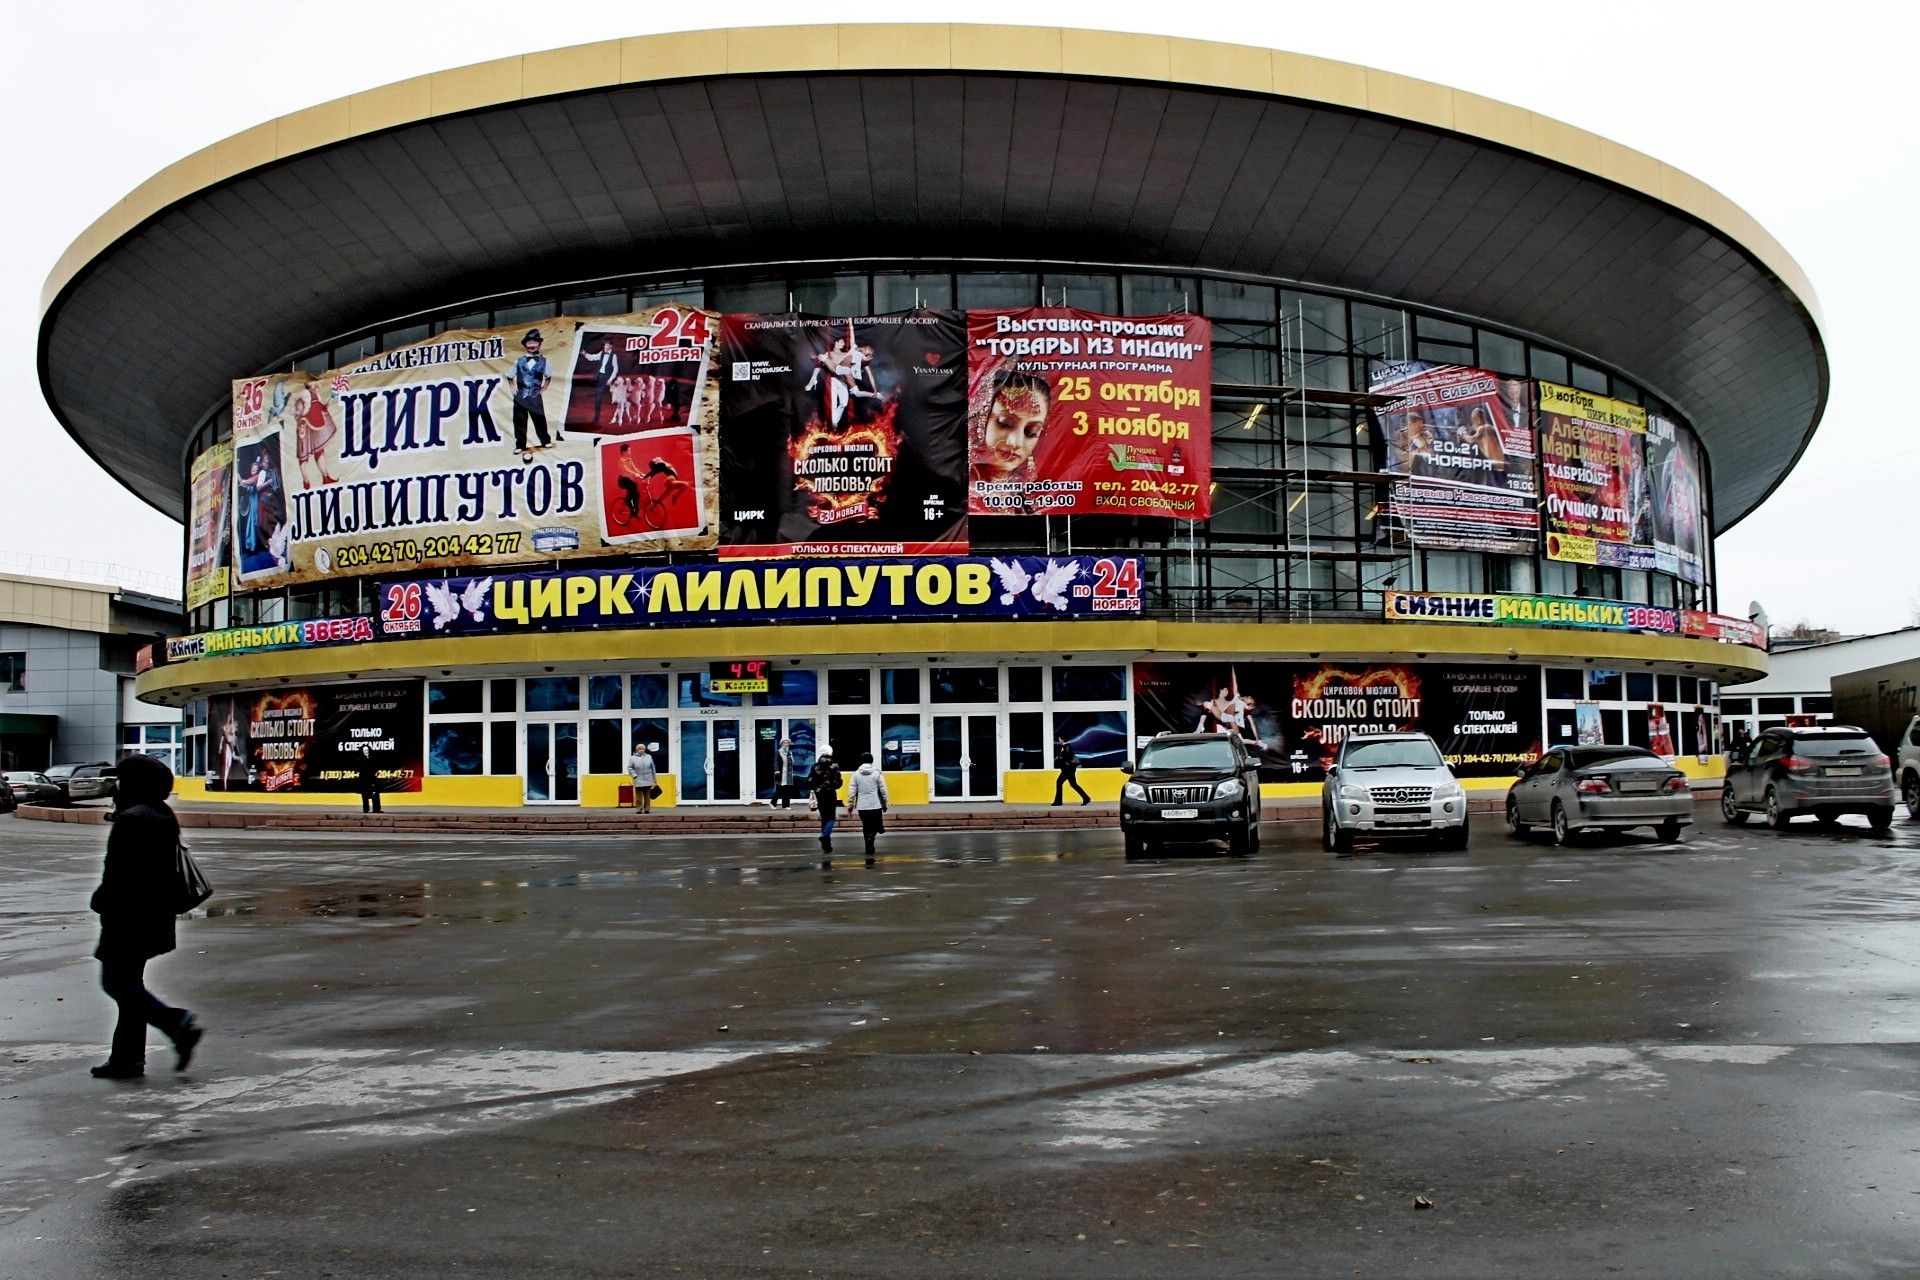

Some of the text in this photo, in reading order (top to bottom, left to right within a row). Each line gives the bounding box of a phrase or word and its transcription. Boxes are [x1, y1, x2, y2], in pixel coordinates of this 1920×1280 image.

[652, 308, 712, 347] 24
[744, 320, 797, 330] СКАНДАЛЬНОЕ
[854, 317, 902, 325] ВЗОРВАВШЕЕ
[997, 316, 1184, 337] Выставка-продажа
[627, 338, 647, 350] ПО
[1087, 339, 1115, 355] ИЗ
[640, 348, 701, 363] НОЯБРЯ
[1017, 361, 1173, 374] КУЛЬТУРНАЯ ПРОГРАММА
[1058, 376, 1201, 411] 25 октября
[1428, 390, 1438, 403] В
[1441, 379, 1495, 401] СИБИРИ
[1543, 385, 1554, 399] 19
[340, 377, 502, 468] ЦИРК
[1072, 411, 1190, 443] 3 ноября
[844, 444, 874, 452] МЮЗИКЛ
[794, 457, 893, 475] СКОЛЬКО СТОИТ
[1428, 455, 1492, 471] НОЯБРЯ
[812, 477, 872, 492] ЛЮБОВЬ?
[976, 481, 1083, 494] Время работы:
[1094, 479, 1199, 496] тел. 204-42-77
[1507, 480, 1534, 490] 19.00
[291, 461, 584, 541] ЛИЛИПУТОВ
[983, 496, 1022, 507] 10.00
[1038, 496, 1075, 506] 19.00
[1096, 495, 1195, 511] ВХОД СВОБОДНЫЙ
[734, 510, 765, 521] ЦИРК
[836, 504, 863, 519] НОЯБРЯ
[924, 508, 944, 520] 16+
[1547, 494, 1598, 518] Лучшие
[1601, 506, 1630, 524] хиты
[337, 546, 369, 568] 204
[371, 543, 394, 564] 42
[424, 535, 461, 557] 204
[465, 533, 493, 555] 42
[496, 531, 522, 553] 77
[791, 543, 904, 554] ТОЛЬКО 6 СПЕКТАКЛЕЙ
[1093, 559, 1142, 598] 24
[494, 563, 992, 625] ЦИРК ЛИЛИПУТОВ
[1074, 585, 1090, 597] ПО
[388, 583, 421, 620] 26
[1093, 598, 1141, 610] НОЯБРЯ
[1395, 595, 1494, 618] СИЯНИЕ
[1500, 598, 1624, 625] МАЛЕНЬКИХ
[1627, 607, 1676, 632] ЗВЕЗД
[384, 620, 421, 632] ОКТЯБРЯ
[206, 624, 300, 651] МАЛЕНЬКИХ
[304, 617, 374, 641] ЗВЕЗД
[1365, 686, 1398, 695] МЮЗИКЛ
[1292, 698, 1420, 718] СКОЛЬКО СТОИТ
[1468, 710, 1505, 720] ТОЛЬКО
[251, 718, 316, 738] СКОЛЬКО СТОИТ
[350, 728, 382, 738] ТОЛЬКО
[1454, 721, 1518, 734] 6 СПЕКТАКЛЕЙ
[262, 742, 300, 760] ЛЮБОВЬ?
[338, 742, 343, 752] 6
[1291, 762, 1309, 773] 16+
